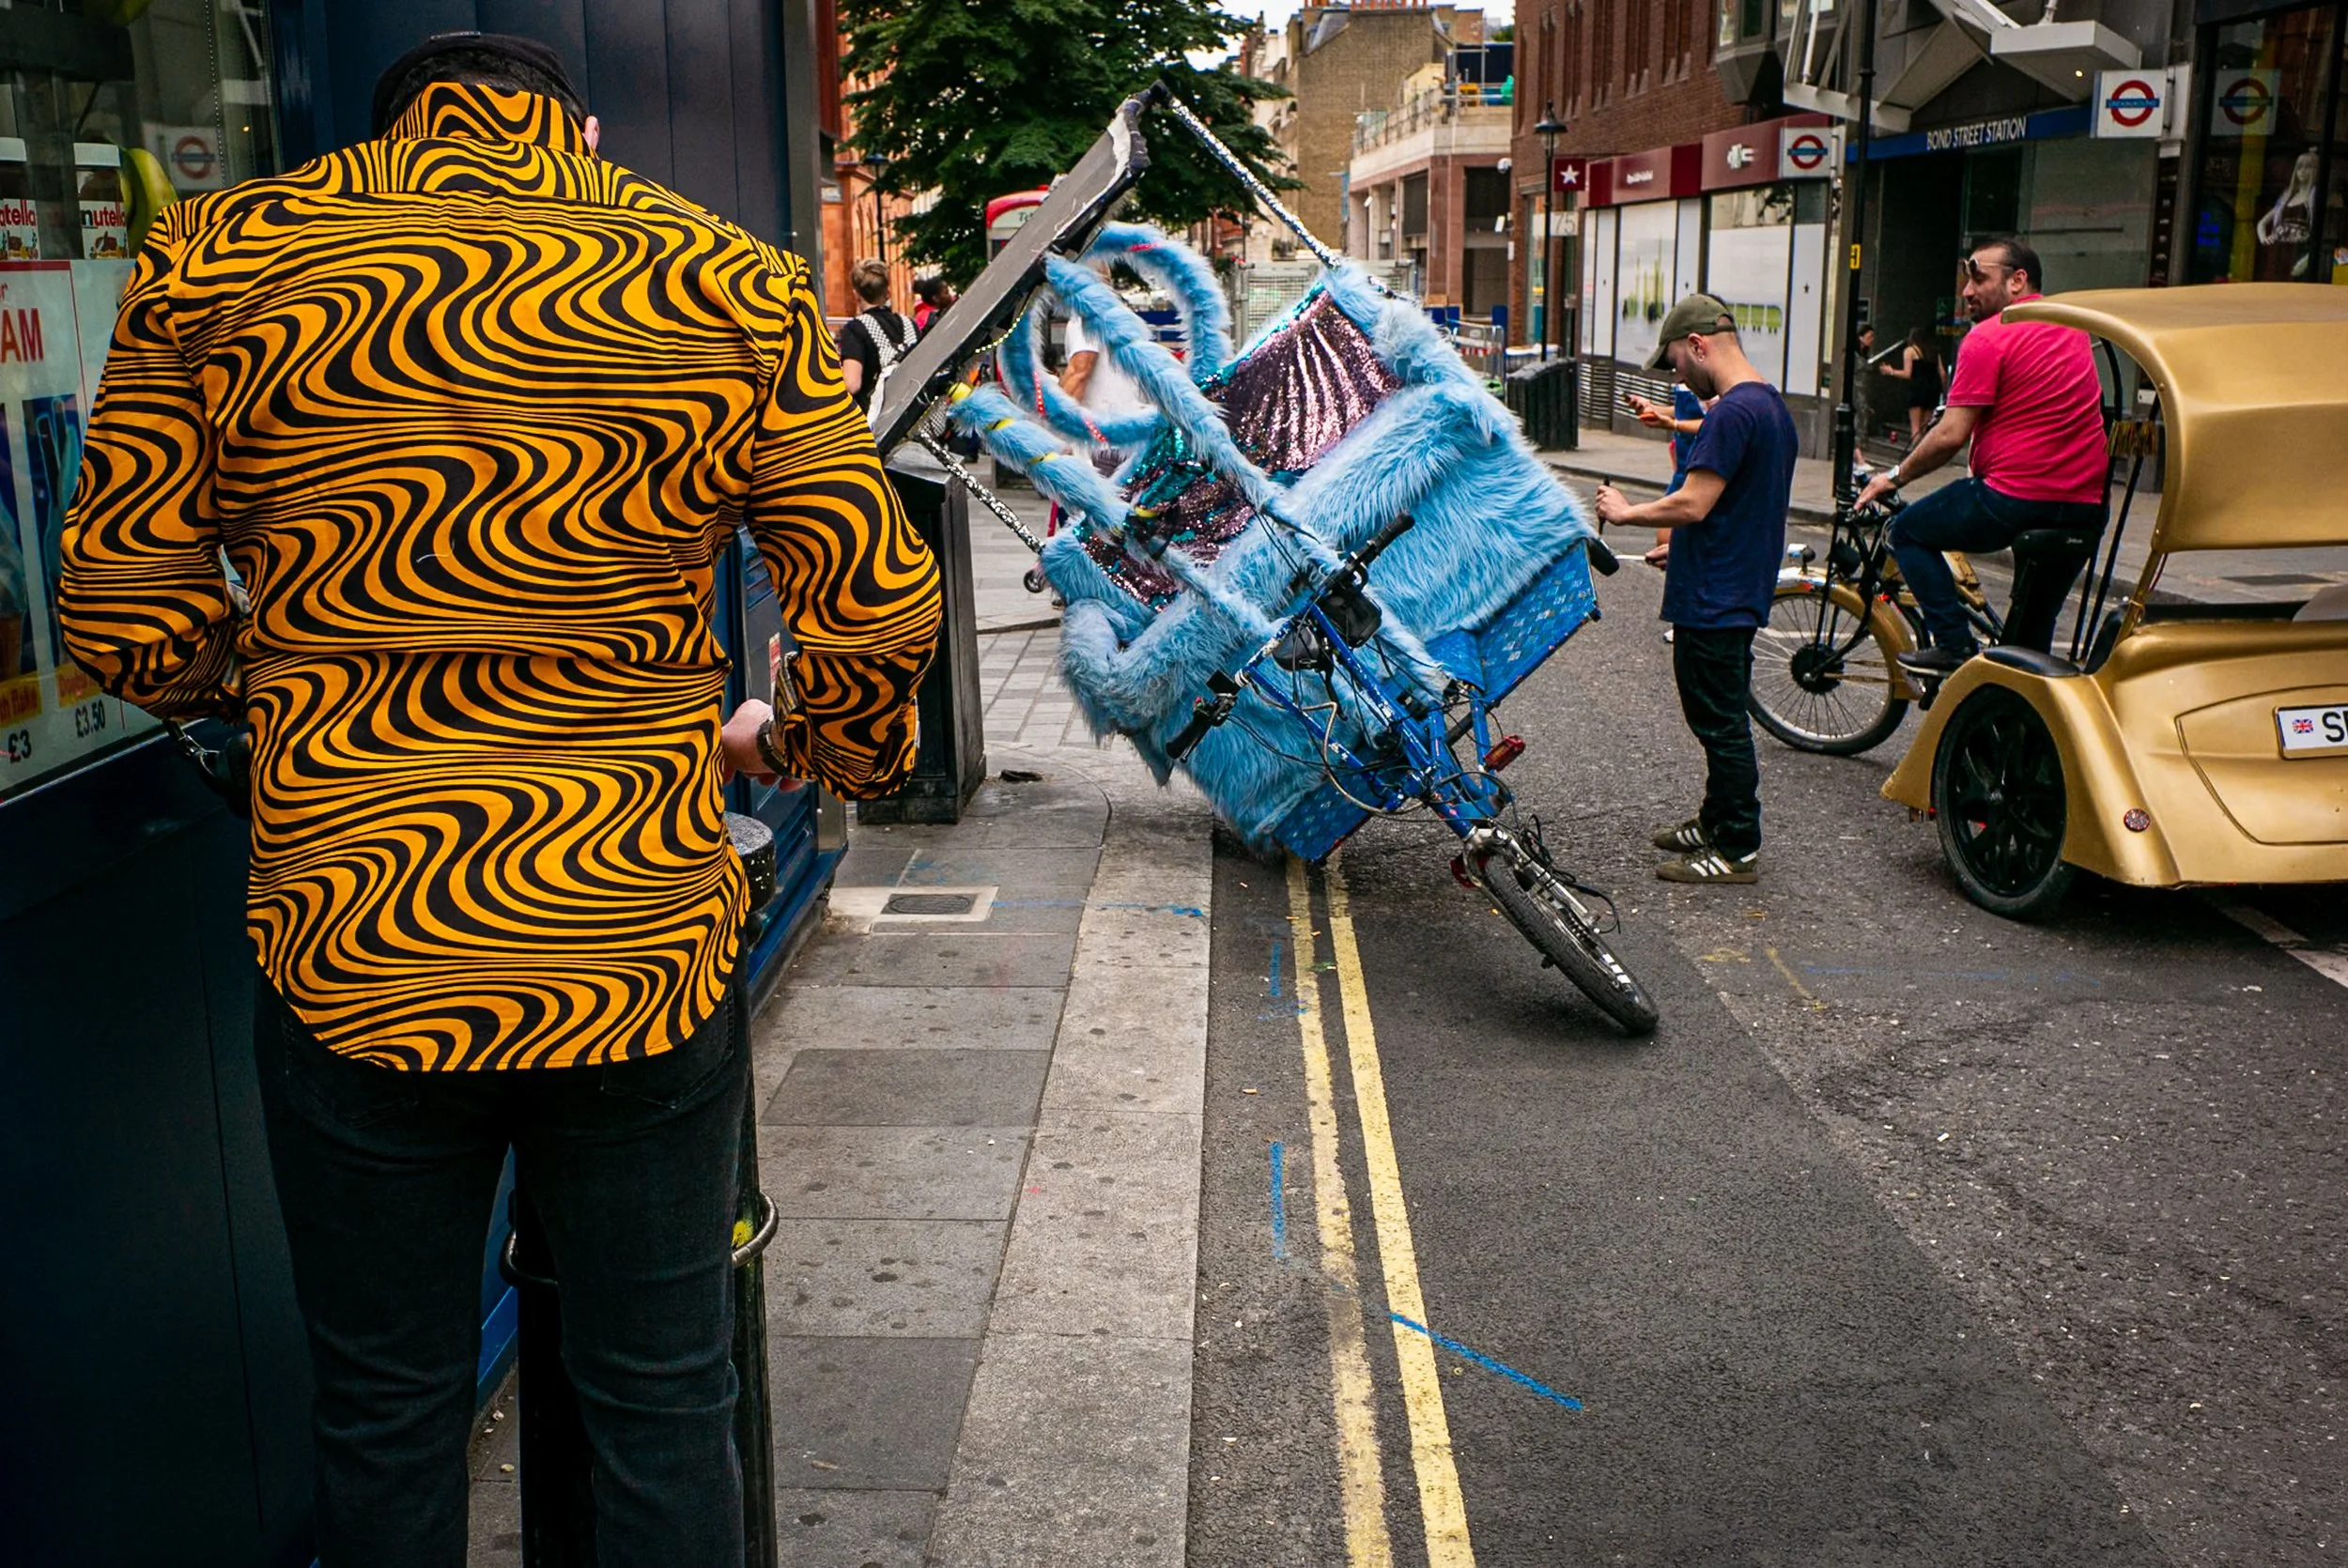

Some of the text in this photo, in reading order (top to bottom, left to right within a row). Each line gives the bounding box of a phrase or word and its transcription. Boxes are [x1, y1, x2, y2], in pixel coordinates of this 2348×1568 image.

[1926, 115, 2027, 150] BOND STREET STATION
[1555, 214, 1576, 235] 75
[0, 307, 44, 363] AM
[75, 699, 106, 738] £3.50
[2322, 711, 2348, 743] S
[8, 729, 32, 764] £3
